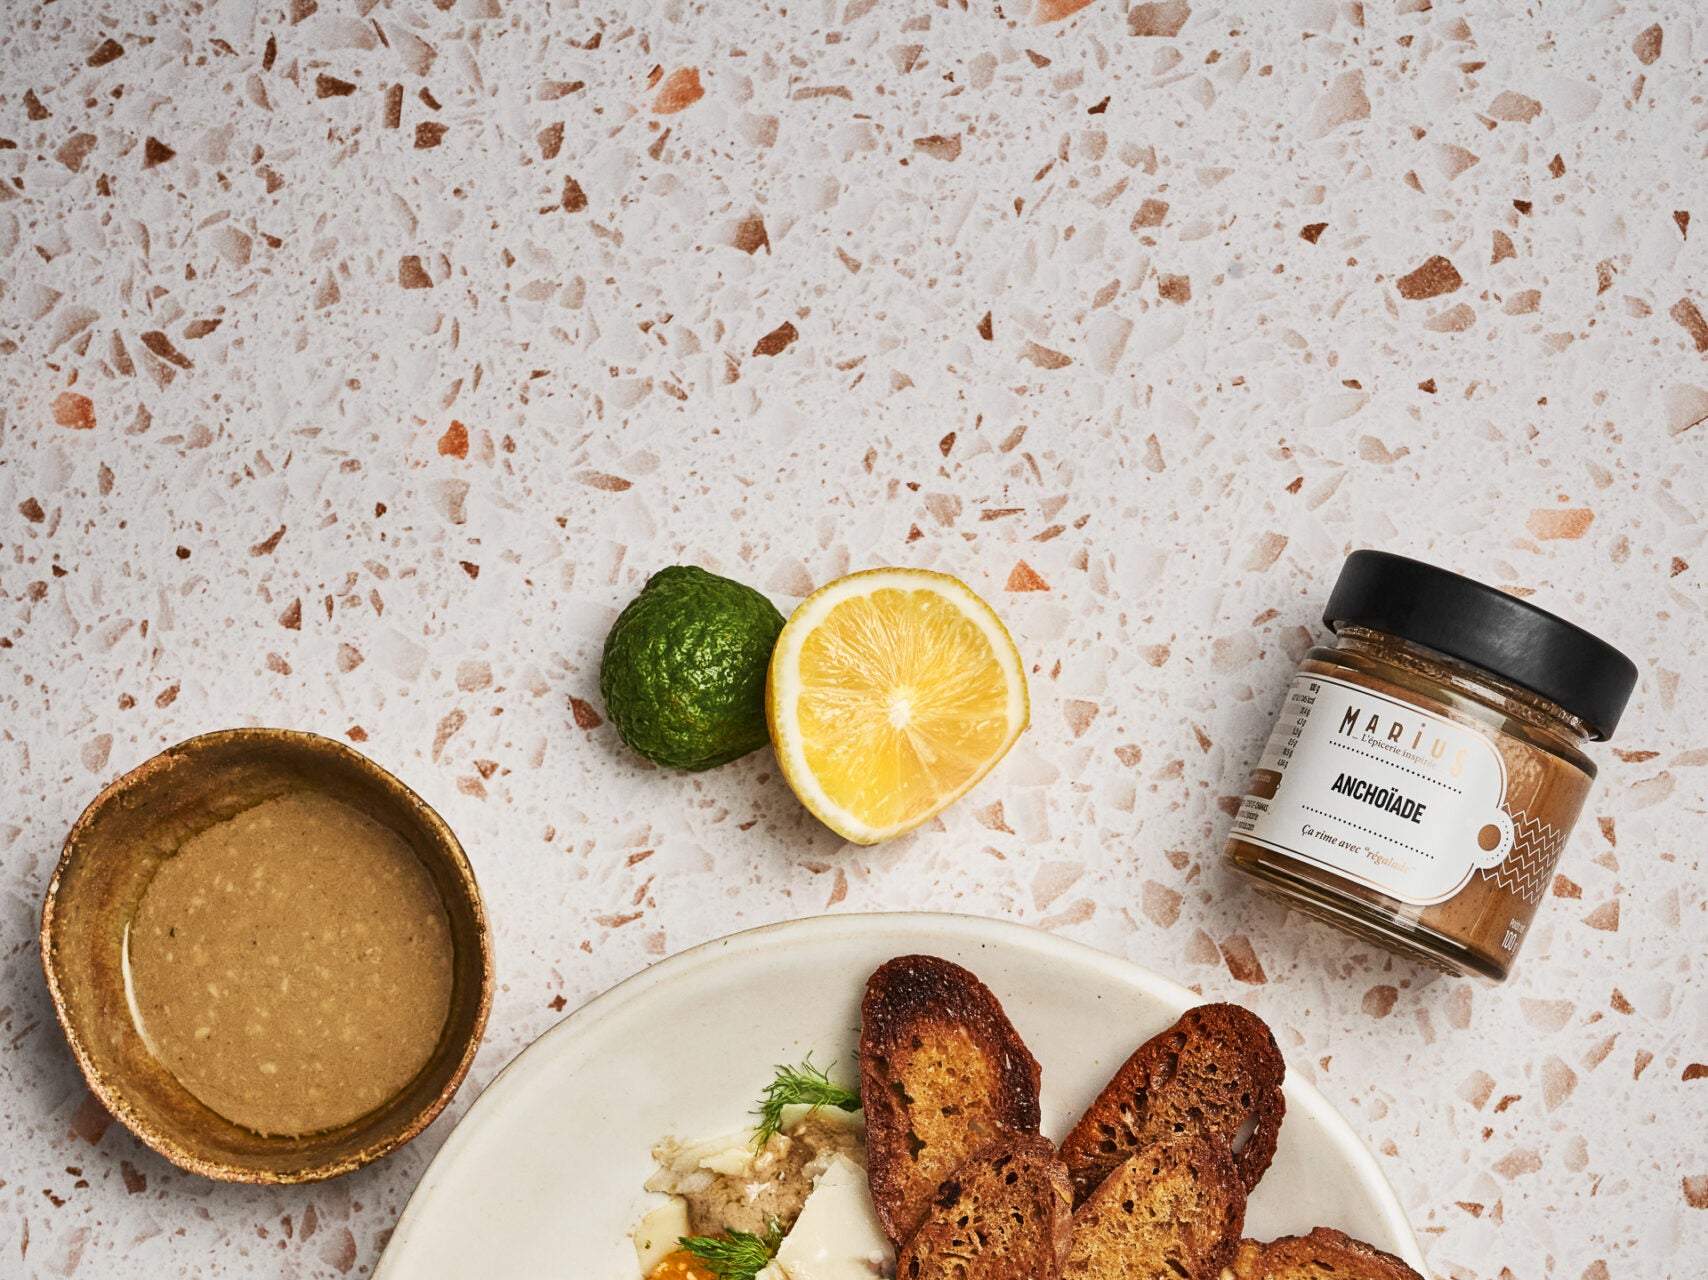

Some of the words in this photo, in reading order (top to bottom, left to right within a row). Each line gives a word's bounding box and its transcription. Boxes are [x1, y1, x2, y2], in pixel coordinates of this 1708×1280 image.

[1331, 773, 1427, 824] ANCHOÏADE
[1301, 824, 1315, 836] Ça
[1315, 830, 1338, 845] rime
[1338, 840, 1361, 854] avec
[1501, 929, 1518, 951] 100
